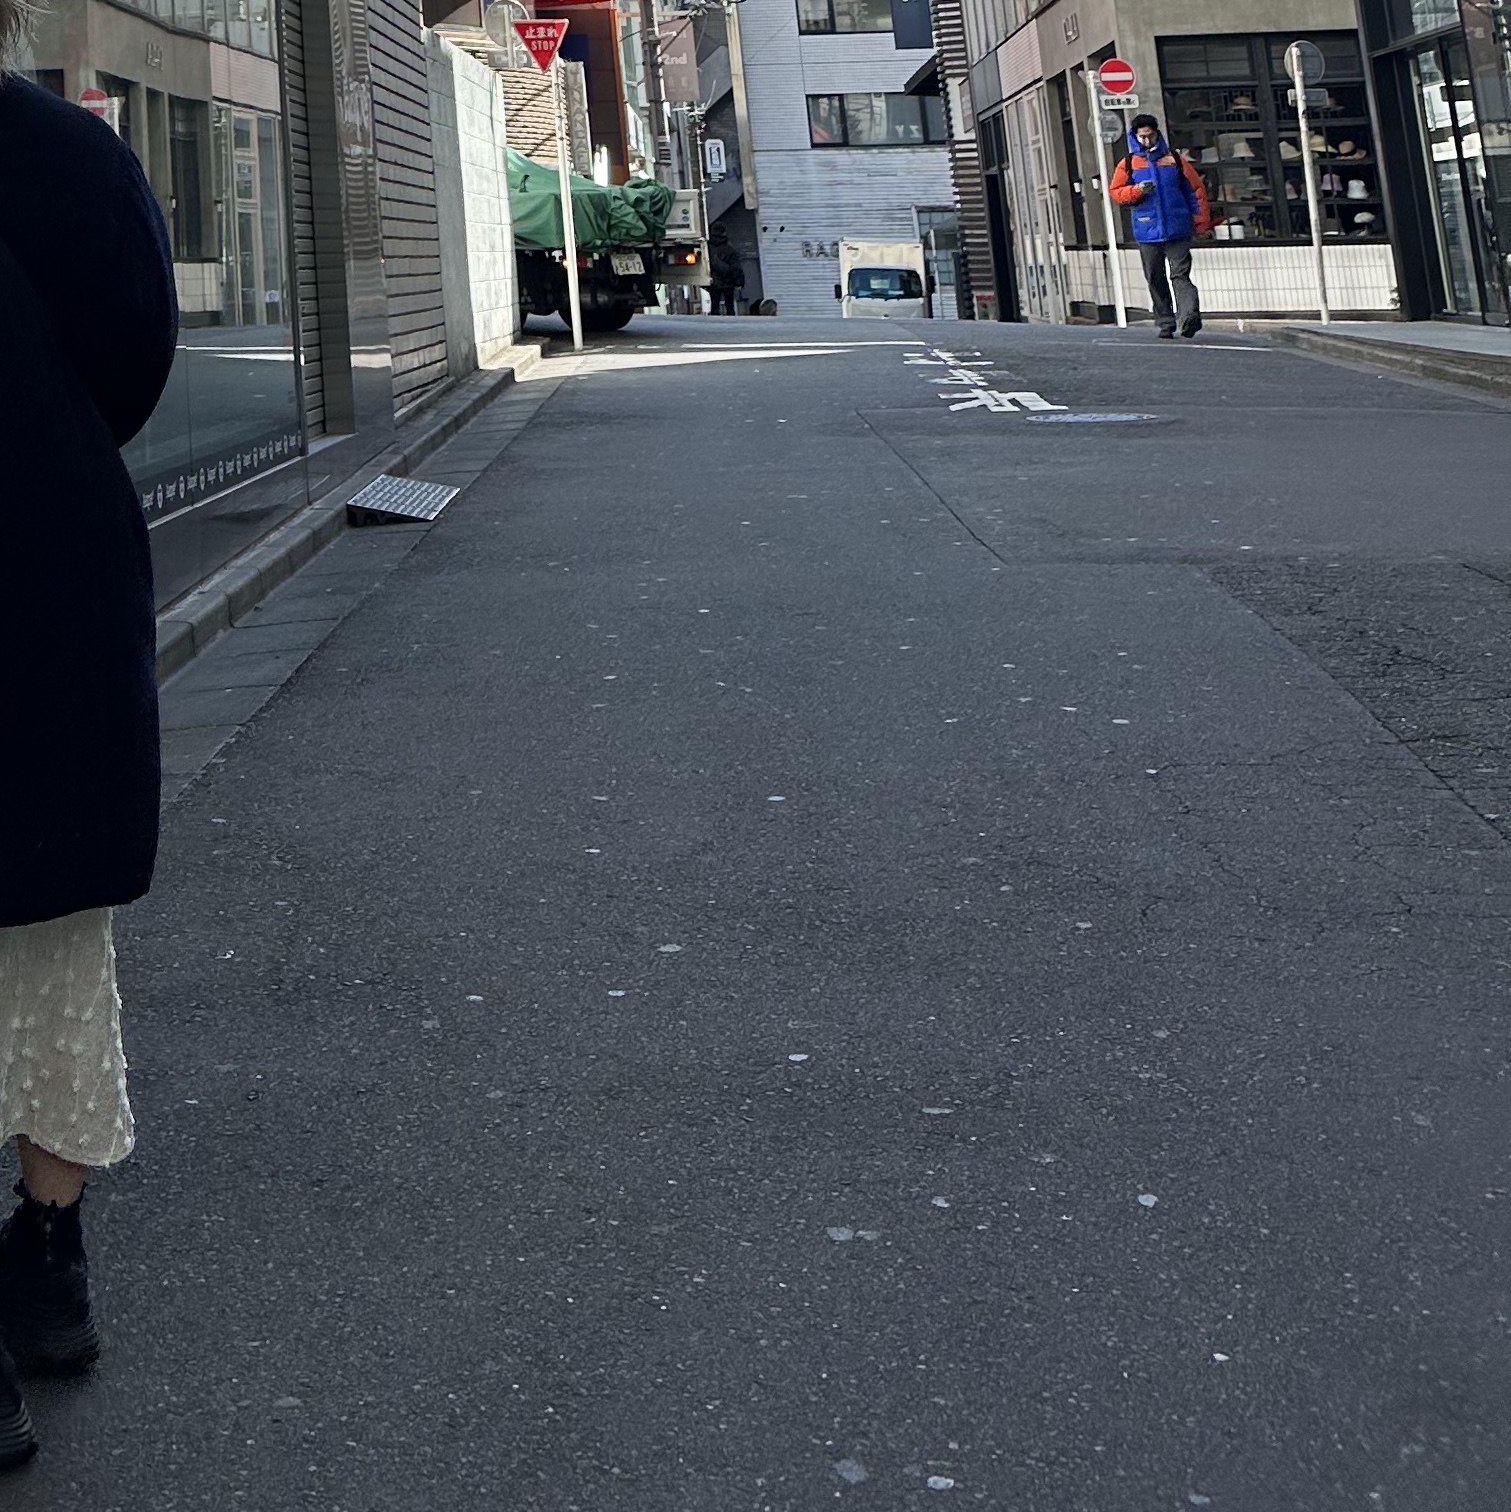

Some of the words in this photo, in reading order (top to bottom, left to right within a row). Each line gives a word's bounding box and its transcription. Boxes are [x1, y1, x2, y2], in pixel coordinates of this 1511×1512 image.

[525, 27, 559, 39] 止まれ
[531, 40, 556, 51] STOP
[663, 52, 687, 65] 2nd
